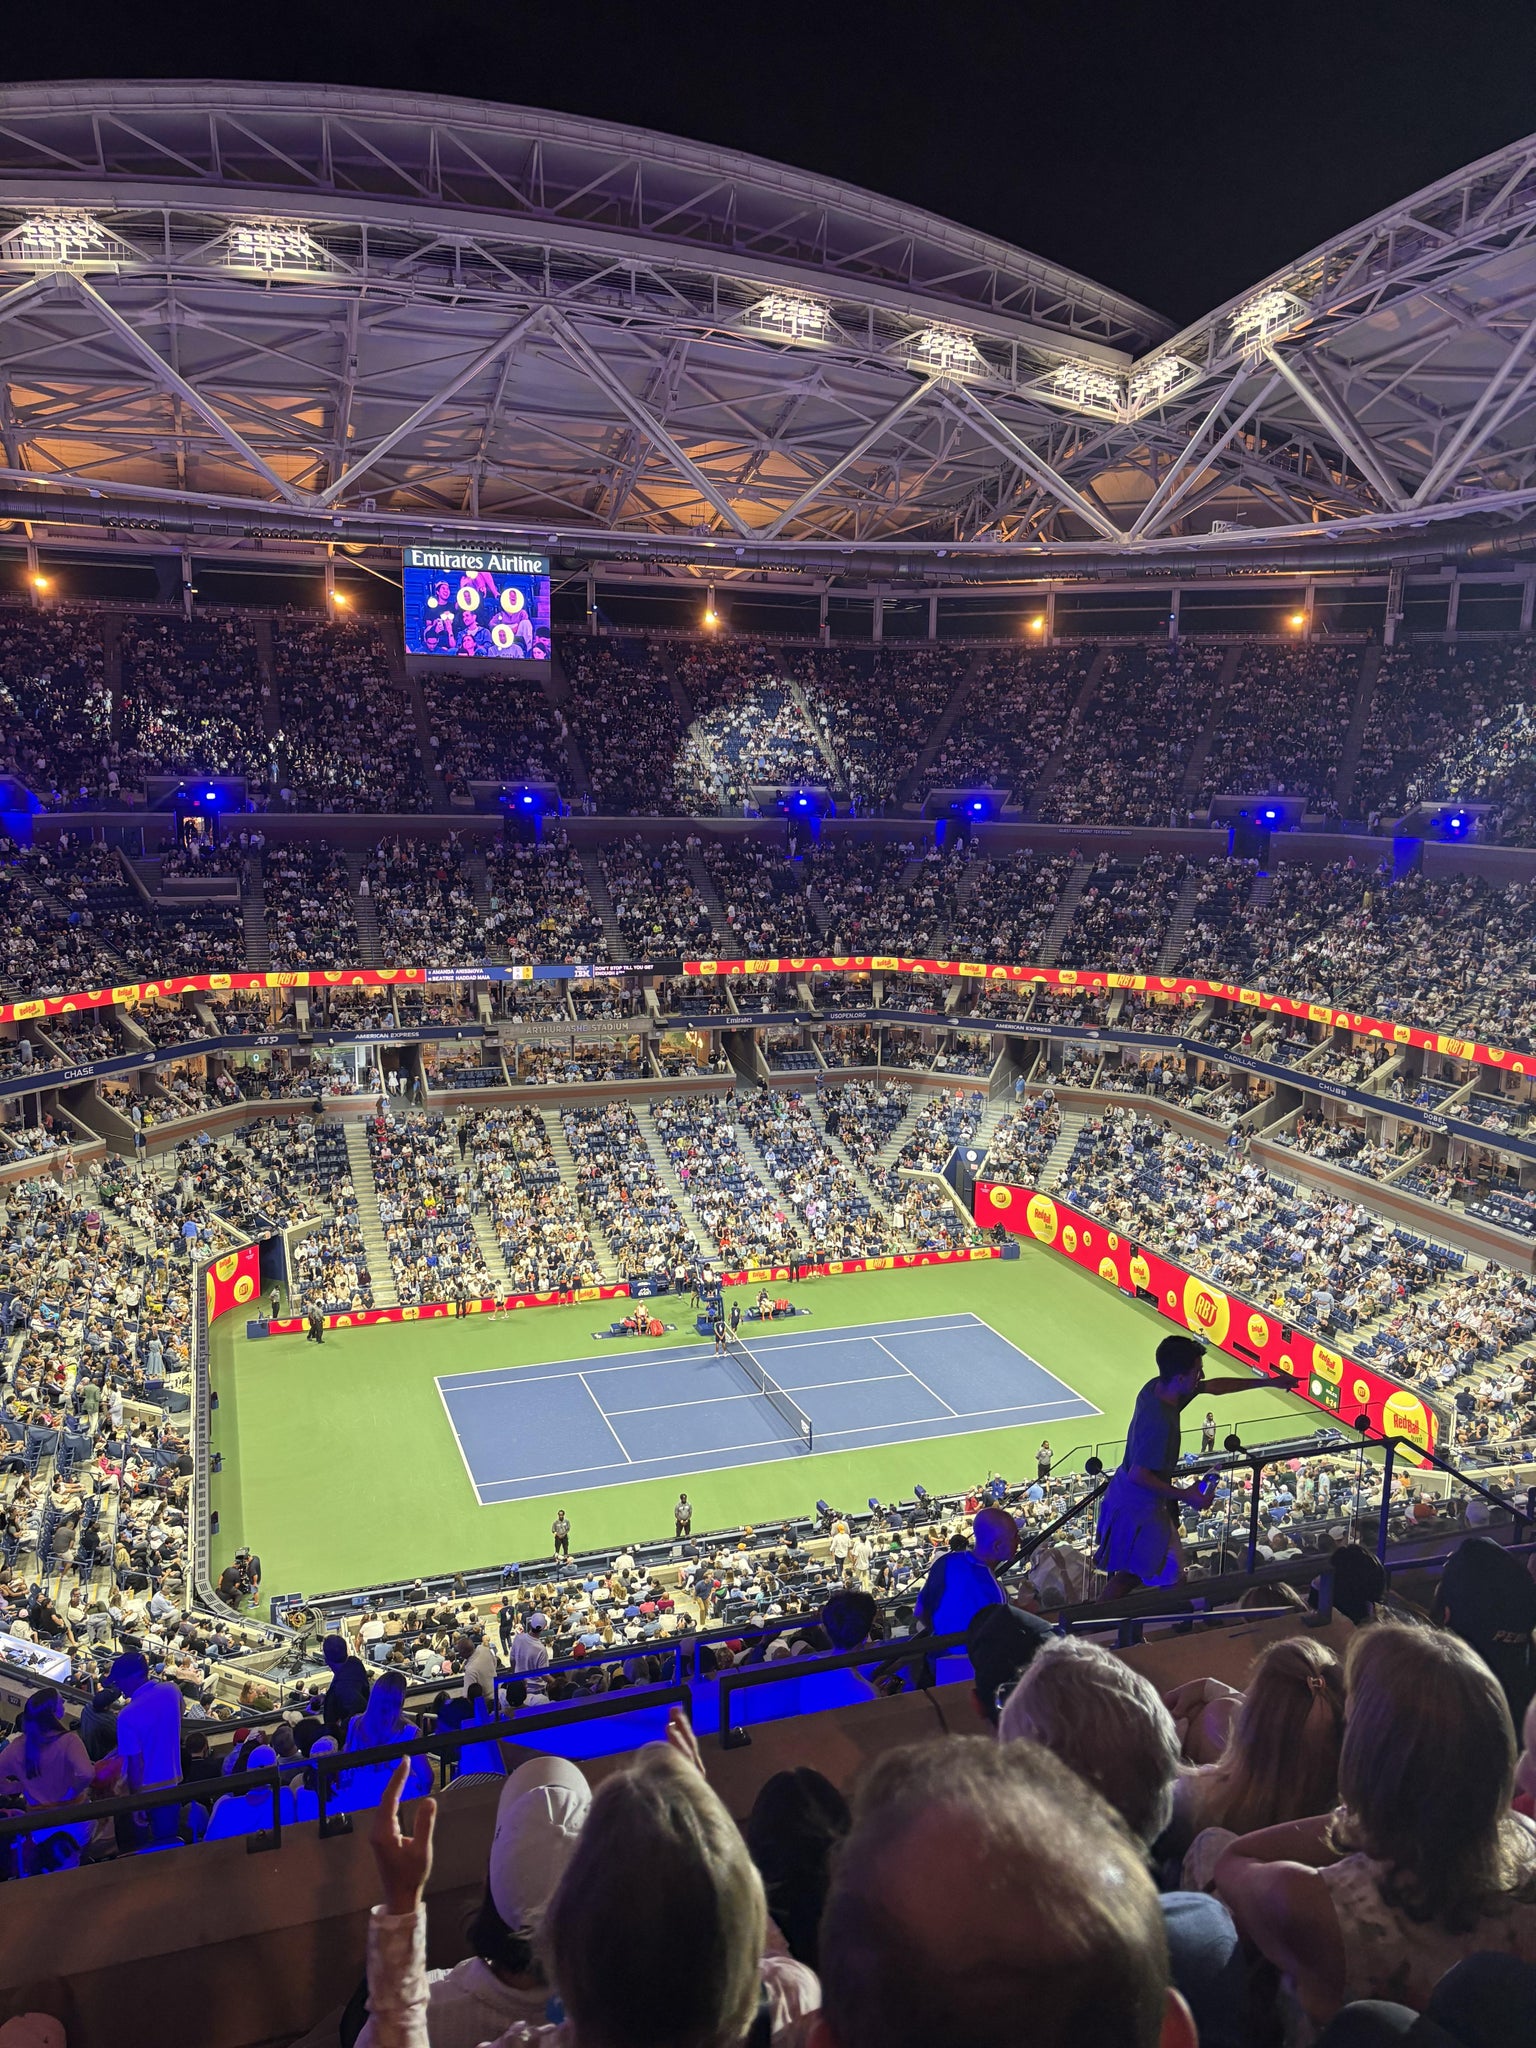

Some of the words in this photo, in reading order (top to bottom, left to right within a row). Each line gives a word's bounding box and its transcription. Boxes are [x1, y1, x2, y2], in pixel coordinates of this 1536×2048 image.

[411, 549, 484, 570] Emirates
[487, 555, 542, 573] Airline
[574, 970, 591, 978] IBM
[726, 1016, 753, 1024] Emirates
[591, 1023, 629, 1032] STADIUM
[995, 1023, 1025, 1031] AMERICAN
[254, 1036, 279, 1045] ATP
[1223, 1053, 1257, 1068] CADILLAC
[64, 1066, 94, 1079] CHASE
[1318, 1082, 1347, 1096] CHUBB
[1423, 1112, 1447, 1125] DOBEL
[1195, 1295, 1217, 1324] RBT
